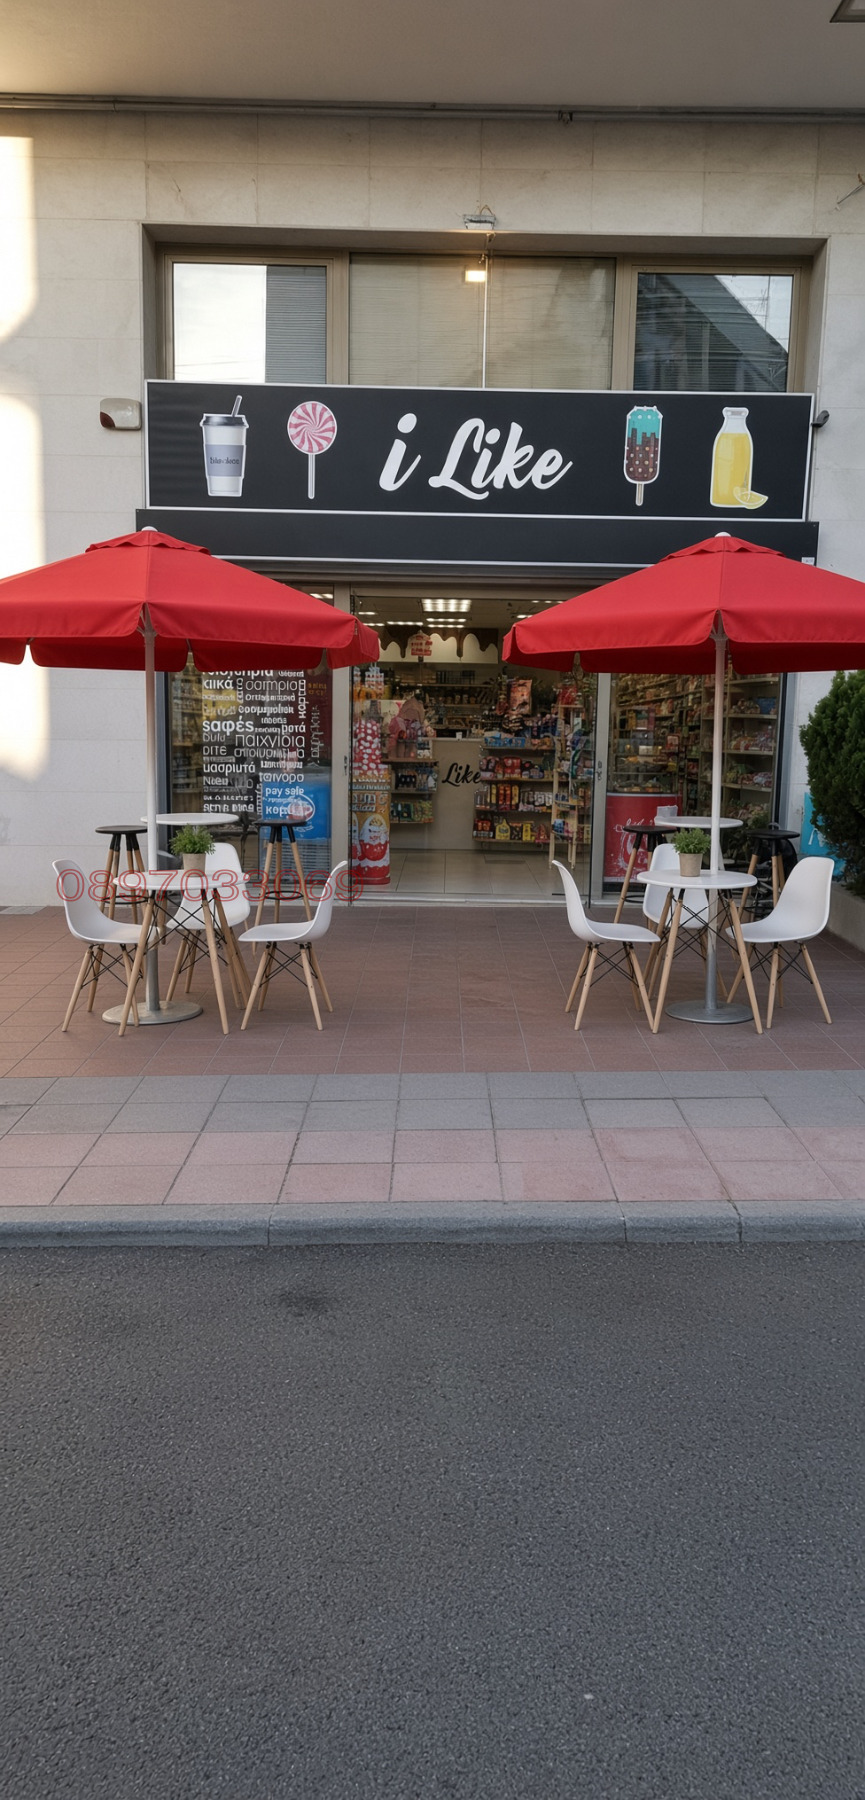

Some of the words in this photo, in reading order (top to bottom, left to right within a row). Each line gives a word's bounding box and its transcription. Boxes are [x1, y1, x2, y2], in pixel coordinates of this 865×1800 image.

[379, 413, 422, 491] i
[428, 417, 573, 500] Like
[441, 762, 481, 787] Like
[265, 786, 283, 797] pay
